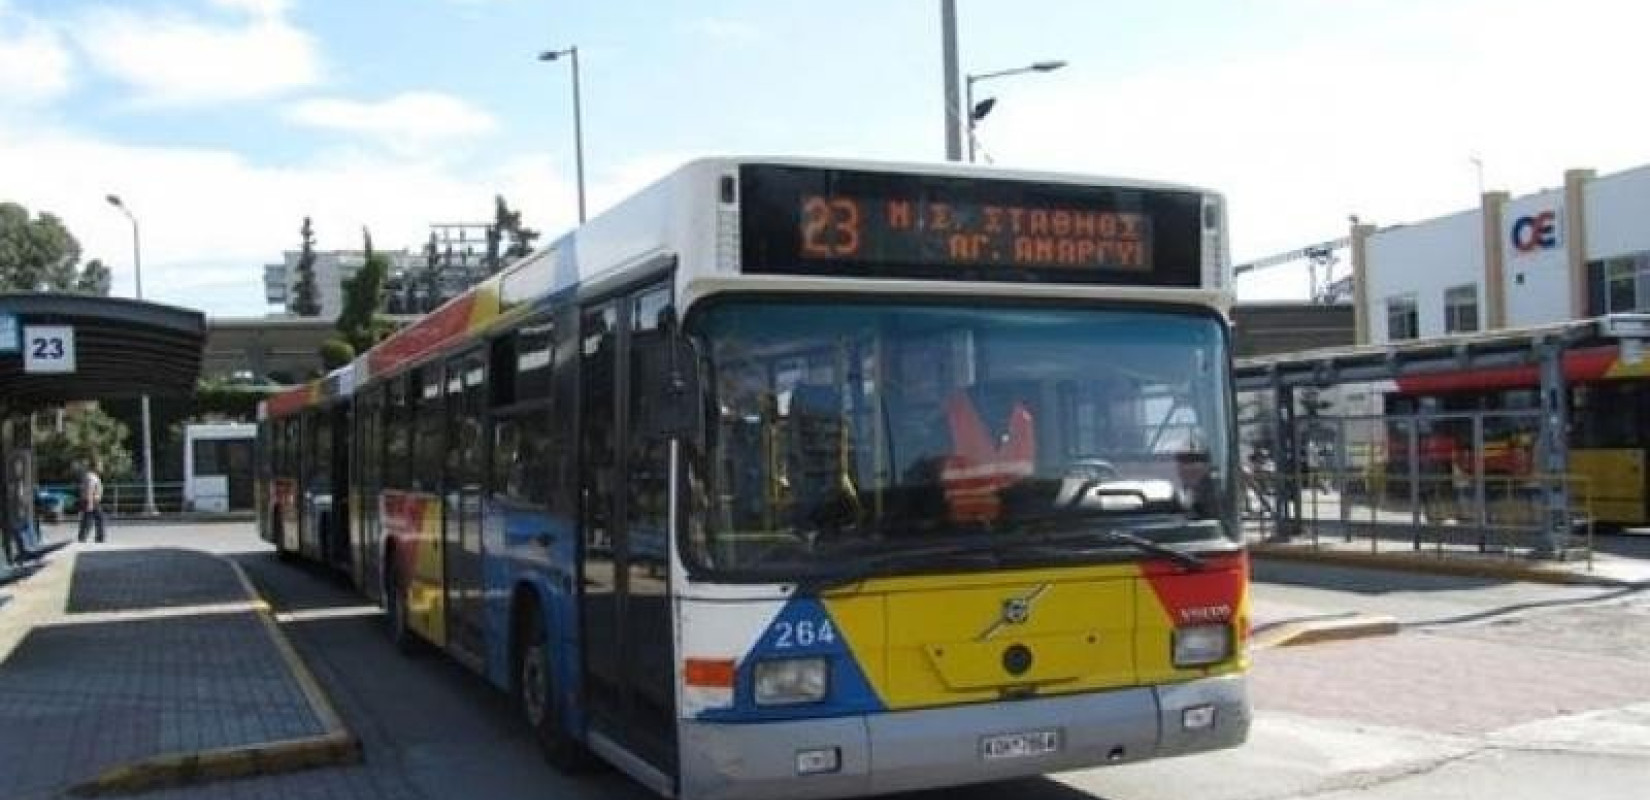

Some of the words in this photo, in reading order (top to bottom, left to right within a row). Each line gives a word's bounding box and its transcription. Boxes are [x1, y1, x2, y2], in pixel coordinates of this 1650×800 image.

[802, 198, 858, 255] 23
[32, 338, 65, 360] 23
[775, 620, 835, 648] 264
